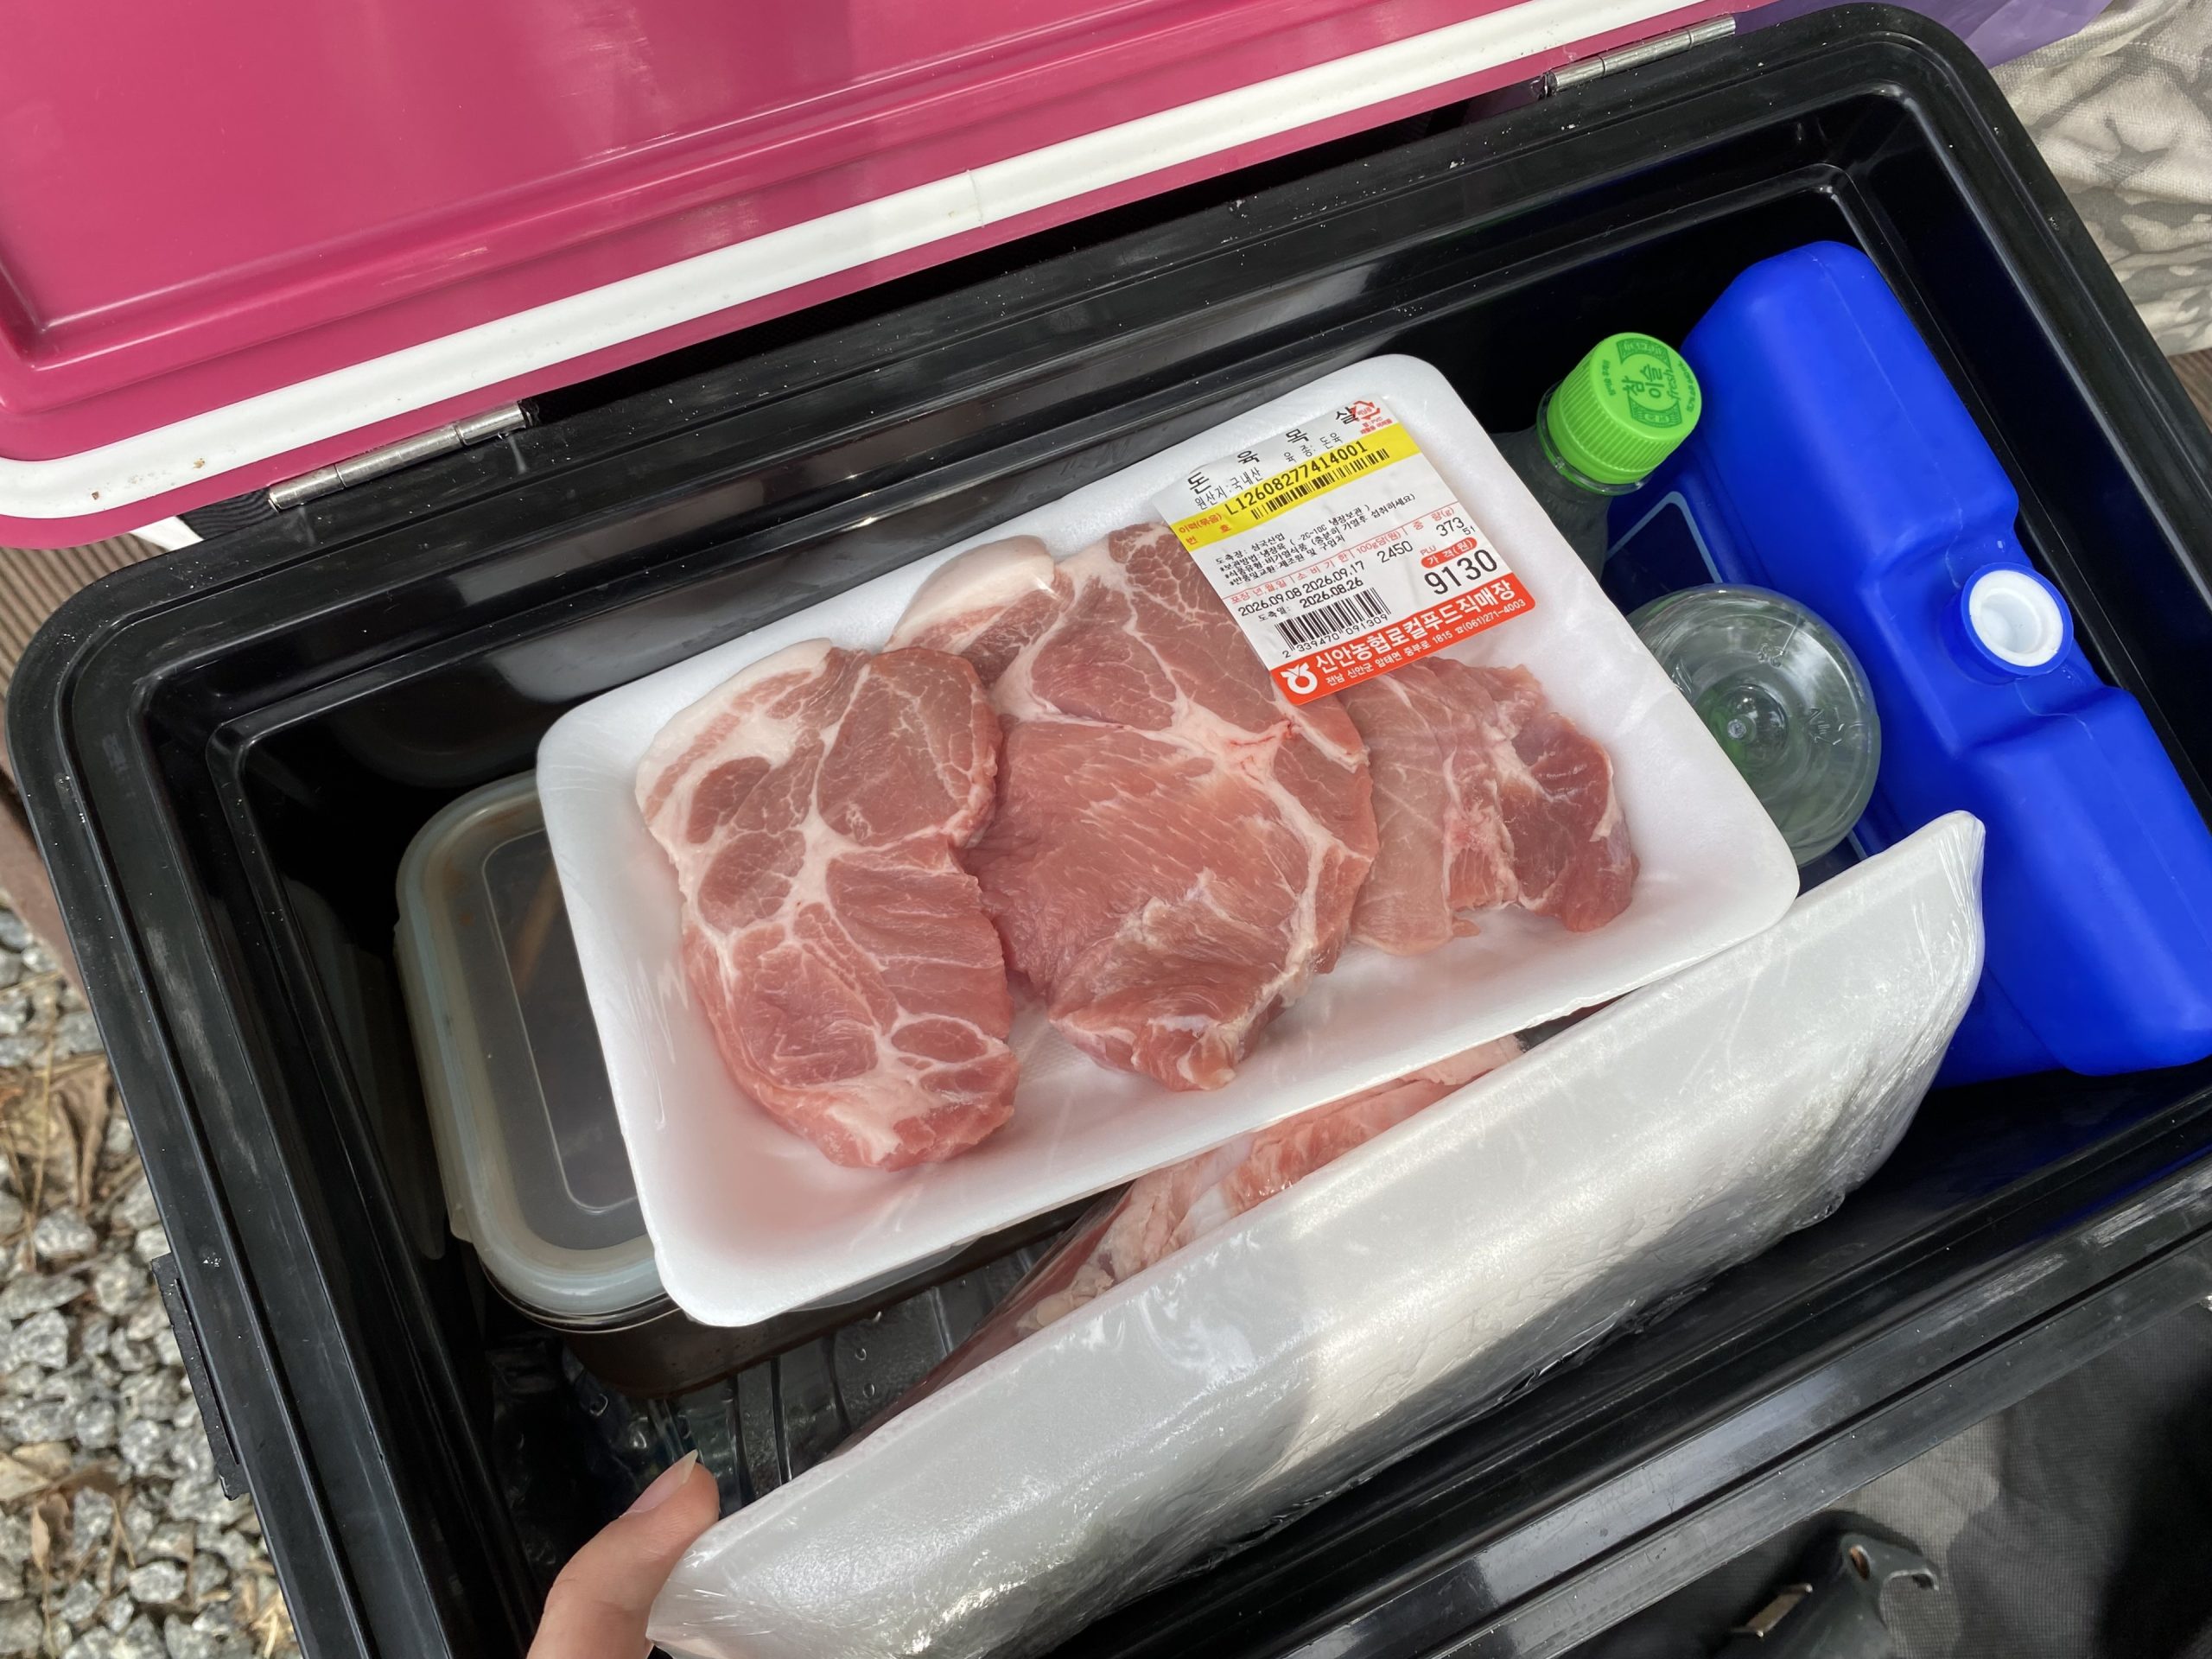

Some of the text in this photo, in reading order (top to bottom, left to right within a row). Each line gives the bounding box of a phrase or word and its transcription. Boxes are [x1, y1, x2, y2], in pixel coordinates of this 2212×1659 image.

[1640, 365, 1664, 397] 이슬
[1187, 406, 1360, 493] 돈 육 목 살
[1320, 432, 1343, 448] 돈육
[1224, 441, 1368, 516] L12608277414001
[1328, 508, 1363, 527] 냉장보관
[1370, 493, 1415, 518] 섭취하세요)
[1179, 512, 1222, 534] 이력(묶음)
[1356, 531, 1402, 554] 100g당(원)
[1420, 525, 1477, 556] PLU 51
[1238, 517, 1465, 617] 2026.09.08 2026.09.17 2450 373
[1424, 549, 1498, 595] 9130
[1299, 577, 1363, 609] 2026.08.26
[1297, 632, 1340, 652] 339470
[1344, 613, 1389, 636] 091309
[1316, 580, 1516, 674] 신안농협로컬푸드직매장
[1325, 674, 1345, 686] 전남
[1346, 664, 1374, 678] 신안군
[1404, 641, 1431, 657] 중부로
[1432, 631, 1452, 644] 1815
[1463, 599, 1526, 632] (061)271-4003
